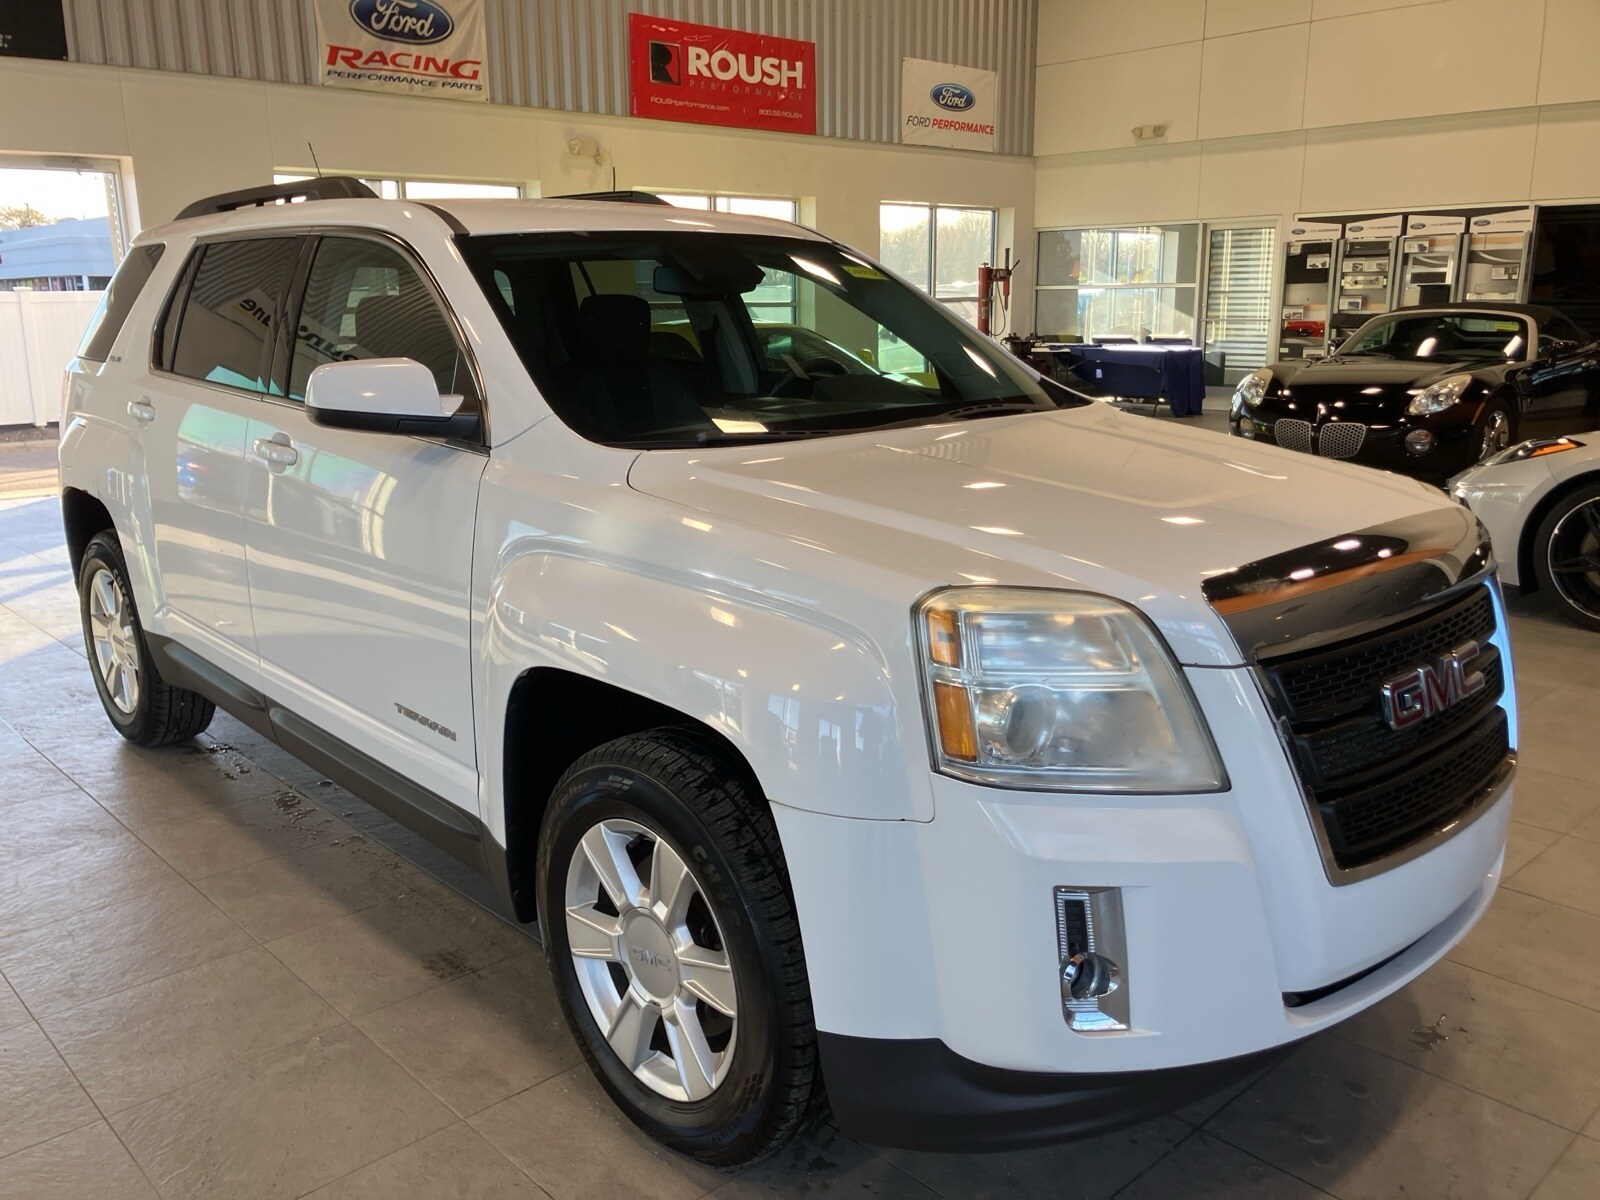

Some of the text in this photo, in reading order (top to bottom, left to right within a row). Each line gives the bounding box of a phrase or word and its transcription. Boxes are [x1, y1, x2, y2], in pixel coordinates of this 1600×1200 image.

[370, 0, 434, 37] Ford
[326, 44, 482, 81] RACING
[687, 46, 804, 89] ROUSH
[327, 69, 483, 92] PERFORMANCE PARTS
[689, 79, 804, 101] PERFORMANCE
[650, 96, 730, 112] ROUSHperformance.com
[939, 87, 967, 108] Ford
[906, 115, 995, 135] FORD PERFORMANCE
[1381, 640, 1486, 731] GMC
[632, 945, 673, 972] GMC
